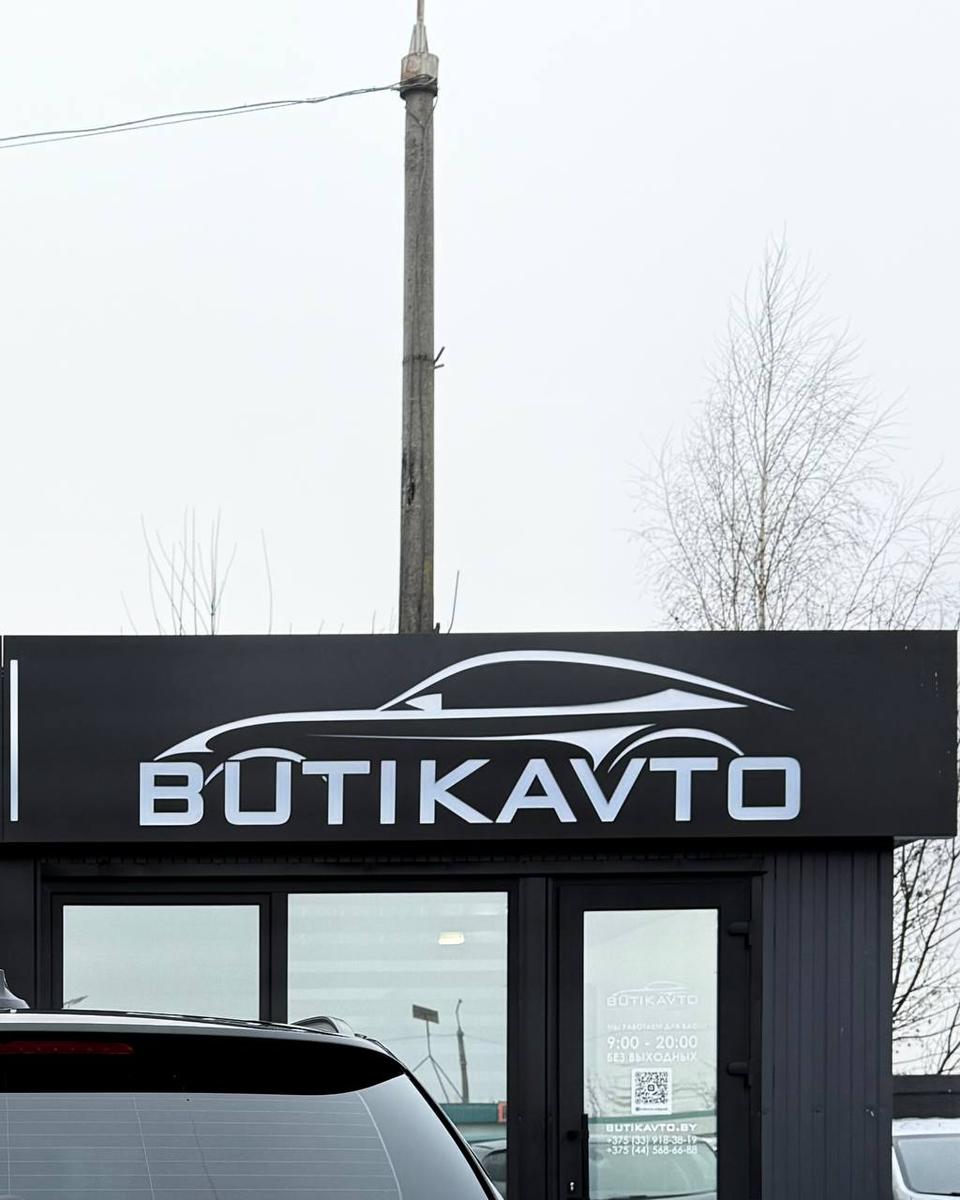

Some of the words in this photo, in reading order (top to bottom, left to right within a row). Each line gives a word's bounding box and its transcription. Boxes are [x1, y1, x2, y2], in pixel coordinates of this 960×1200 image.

[139, 756, 802, 826] BUTIKAVTO
[606, 994, 698, 1007] BUTIKAVTO
[607, 1035, 639, 1049] 9:00
[655, 1035, 698, 1049] 20:00
[607, 1052, 626, 1063] БЕЗ
[628, 1052, 697, 1063] ВЫХОДНЫХ
[606, 1123, 698, 1132] BUTIKAVTO.BY
